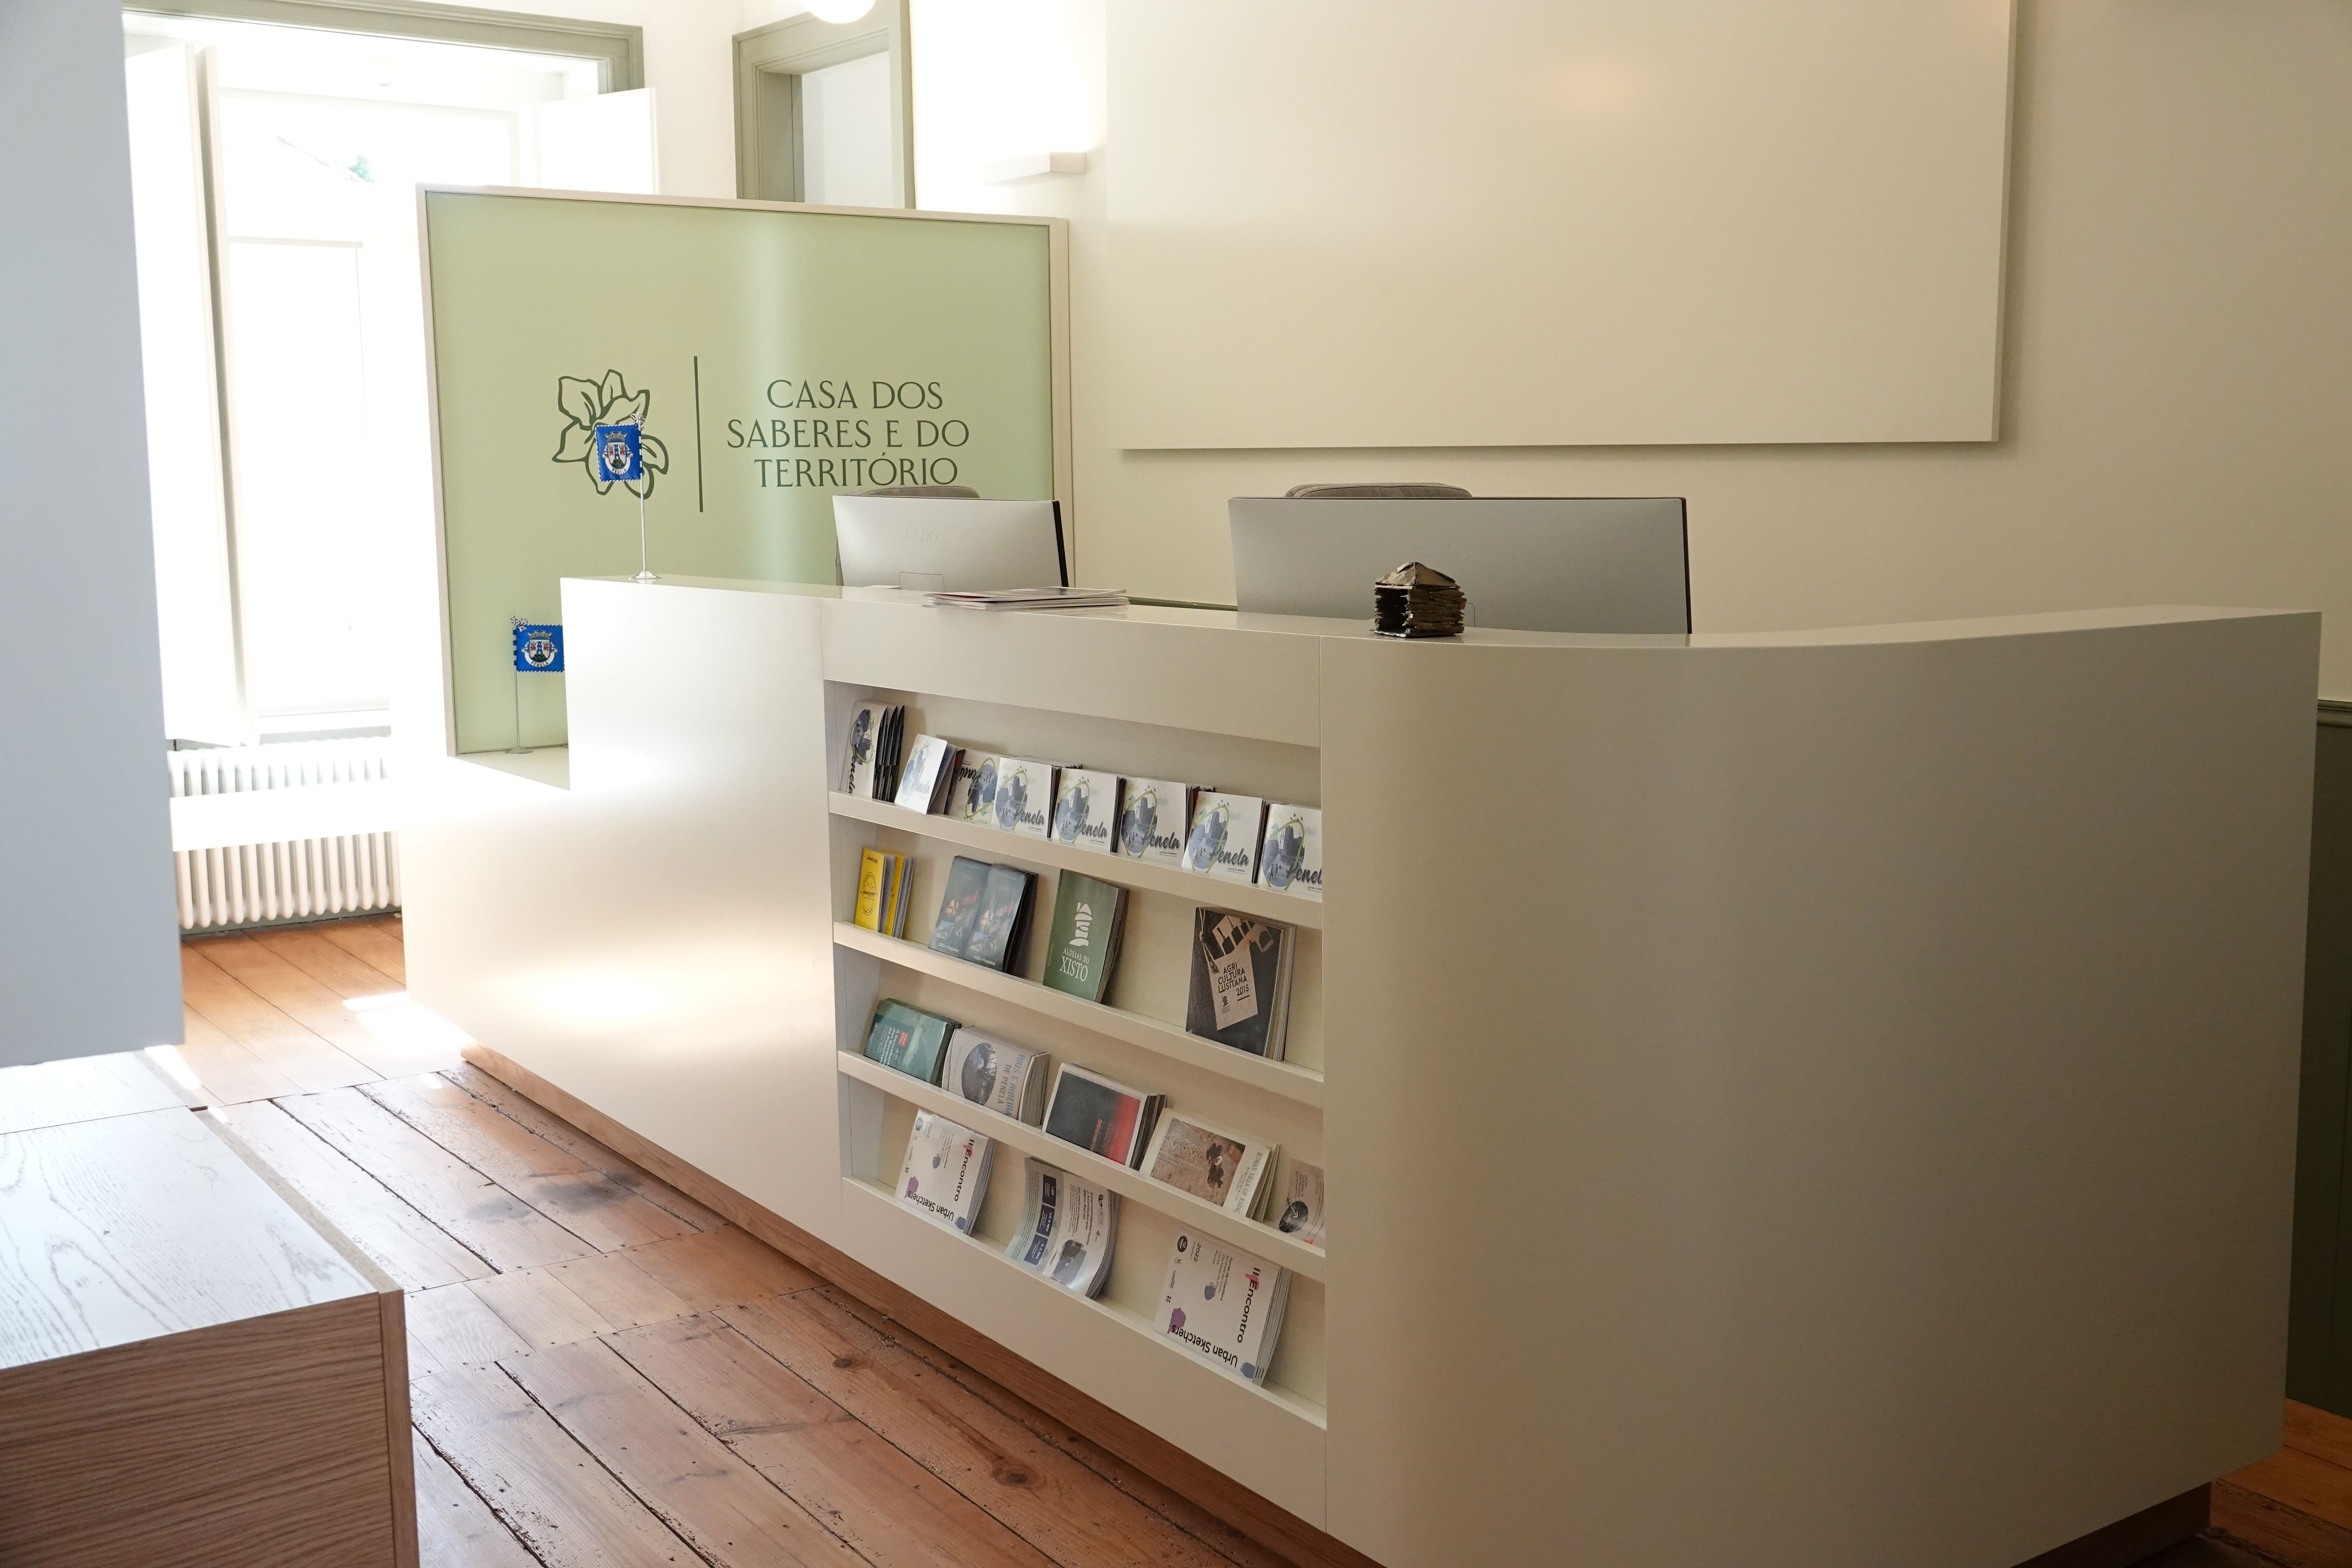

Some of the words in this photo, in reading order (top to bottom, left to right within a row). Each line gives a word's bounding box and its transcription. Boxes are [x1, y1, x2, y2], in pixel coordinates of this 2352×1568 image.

[767, 380, 858, 409] CASA
[872, 381, 943, 410] DOS
[727, 419, 871, 448] SABERES
[885, 420, 903, 447] E
[916, 420, 969, 447] DO
[754, 452, 958, 487] TERRITÓRIO
[1013, 804, 1045, 826] Penela
[1074, 818, 1108, 839] Penela
[1141, 829, 1180, 849] Penela
[1209, 842, 1249, 866] Penela
[1286, 862, 1322, 885] Penel
[1063, 947, 1082, 961] ALDEIAS
[1083, 956, 1090, 964] DO
[1059, 956, 1088, 982] XISTO
[1218, 968, 1245, 985] CULTURA
[1223, 962, 1237, 975] AGRI
[1218, 975, 1247, 993] LUSITANA
[1237, 984, 1249, 996] 2015
[1003, 1064, 1011, 1075] DE
[1013, 1054, 1025, 1074] RIOS
[997, 1076, 1008, 1104] PENELA
[1252, 1152, 1262, 1171] ROMAN
[954, 1148, 972, 1202] Encontro
[1245, 1173, 1255, 1186] VILLA
[907, 1190, 936, 1213] Sketchers
[936, 1204, 954, 1222] Urban
[1194, 1243, 1202, 1262] 2022
[1237, 1279, 1257, 1344] Encontro
[1171, 1324, 1211, 1353] Sketchers
[1213, 1344, 1237, 1368] Urban
